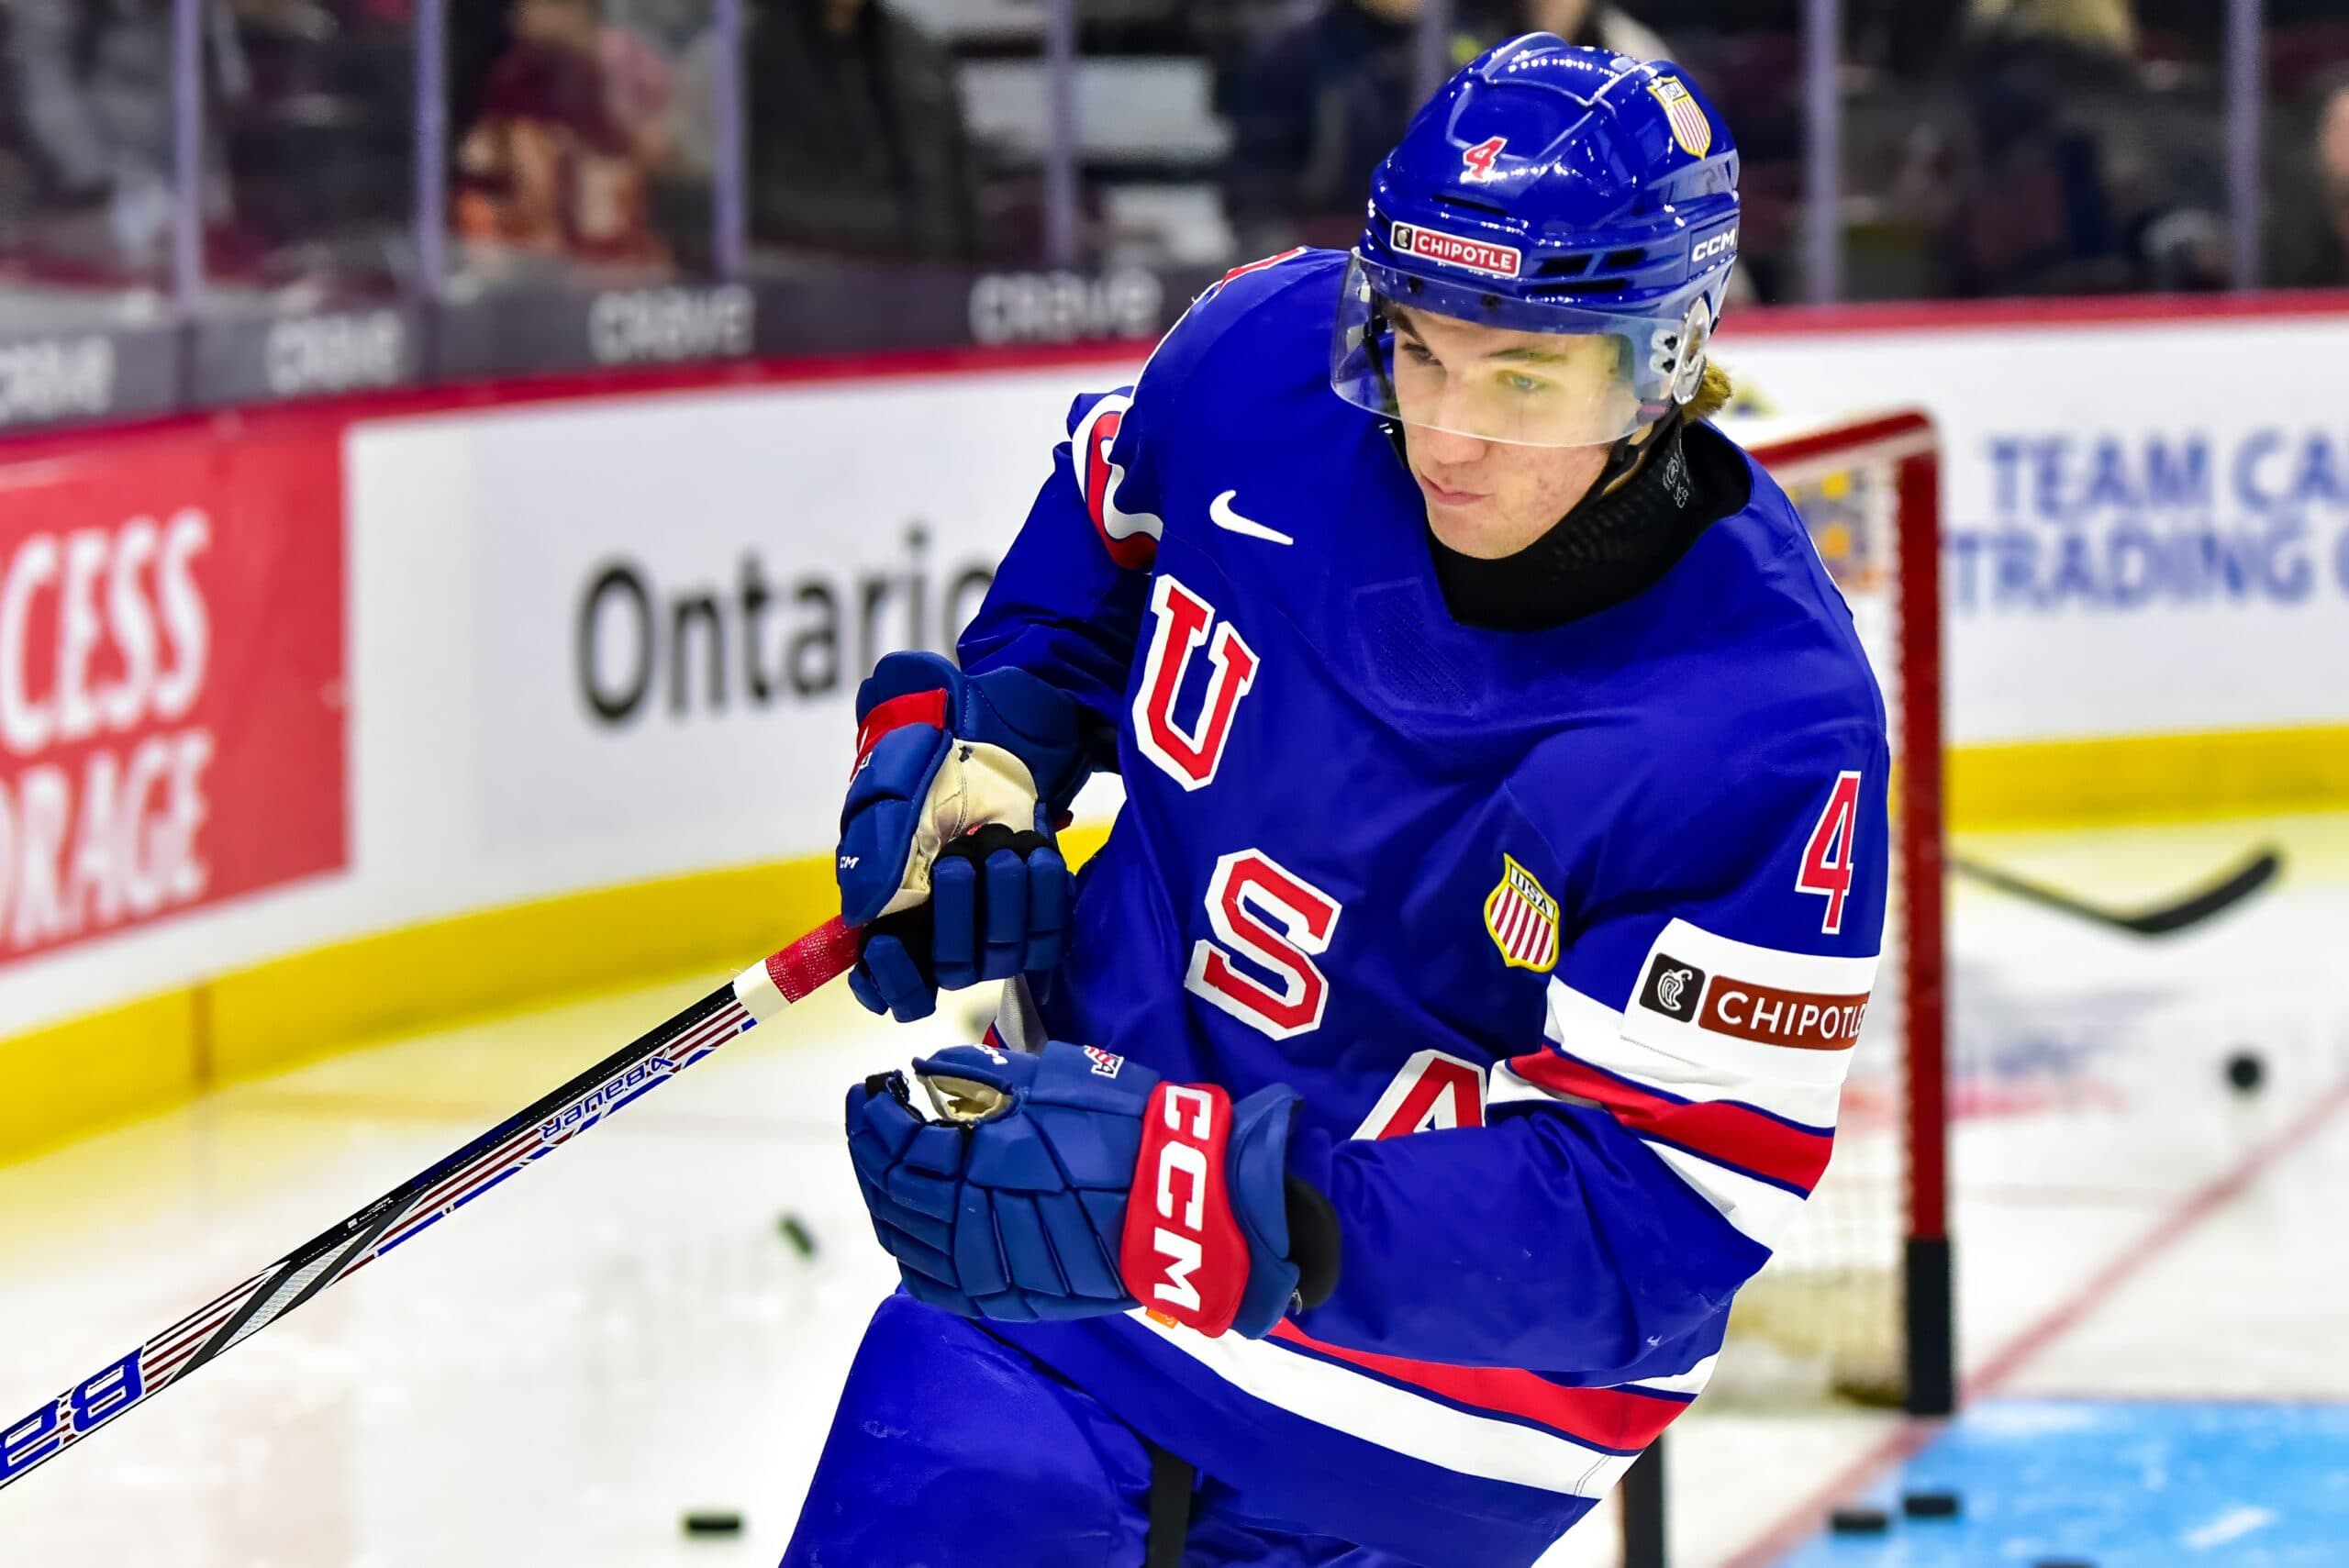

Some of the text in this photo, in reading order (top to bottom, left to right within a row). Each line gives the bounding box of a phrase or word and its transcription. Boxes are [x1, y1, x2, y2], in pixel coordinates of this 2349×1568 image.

[1463, 136, 1508, 183] 4
[1418, 235, 1513, 270] CHIPOTLE
[1691, 228, 1736, 262] CCM
[1985, 432, 2212, 520] TEAM
[1943, 516, 2317, 612] TRADING
[1795, 770, 1862, 935] 4
[1515, 872, 1548, 914] USA
[1153, 1085, 1211, 1312] CCM
